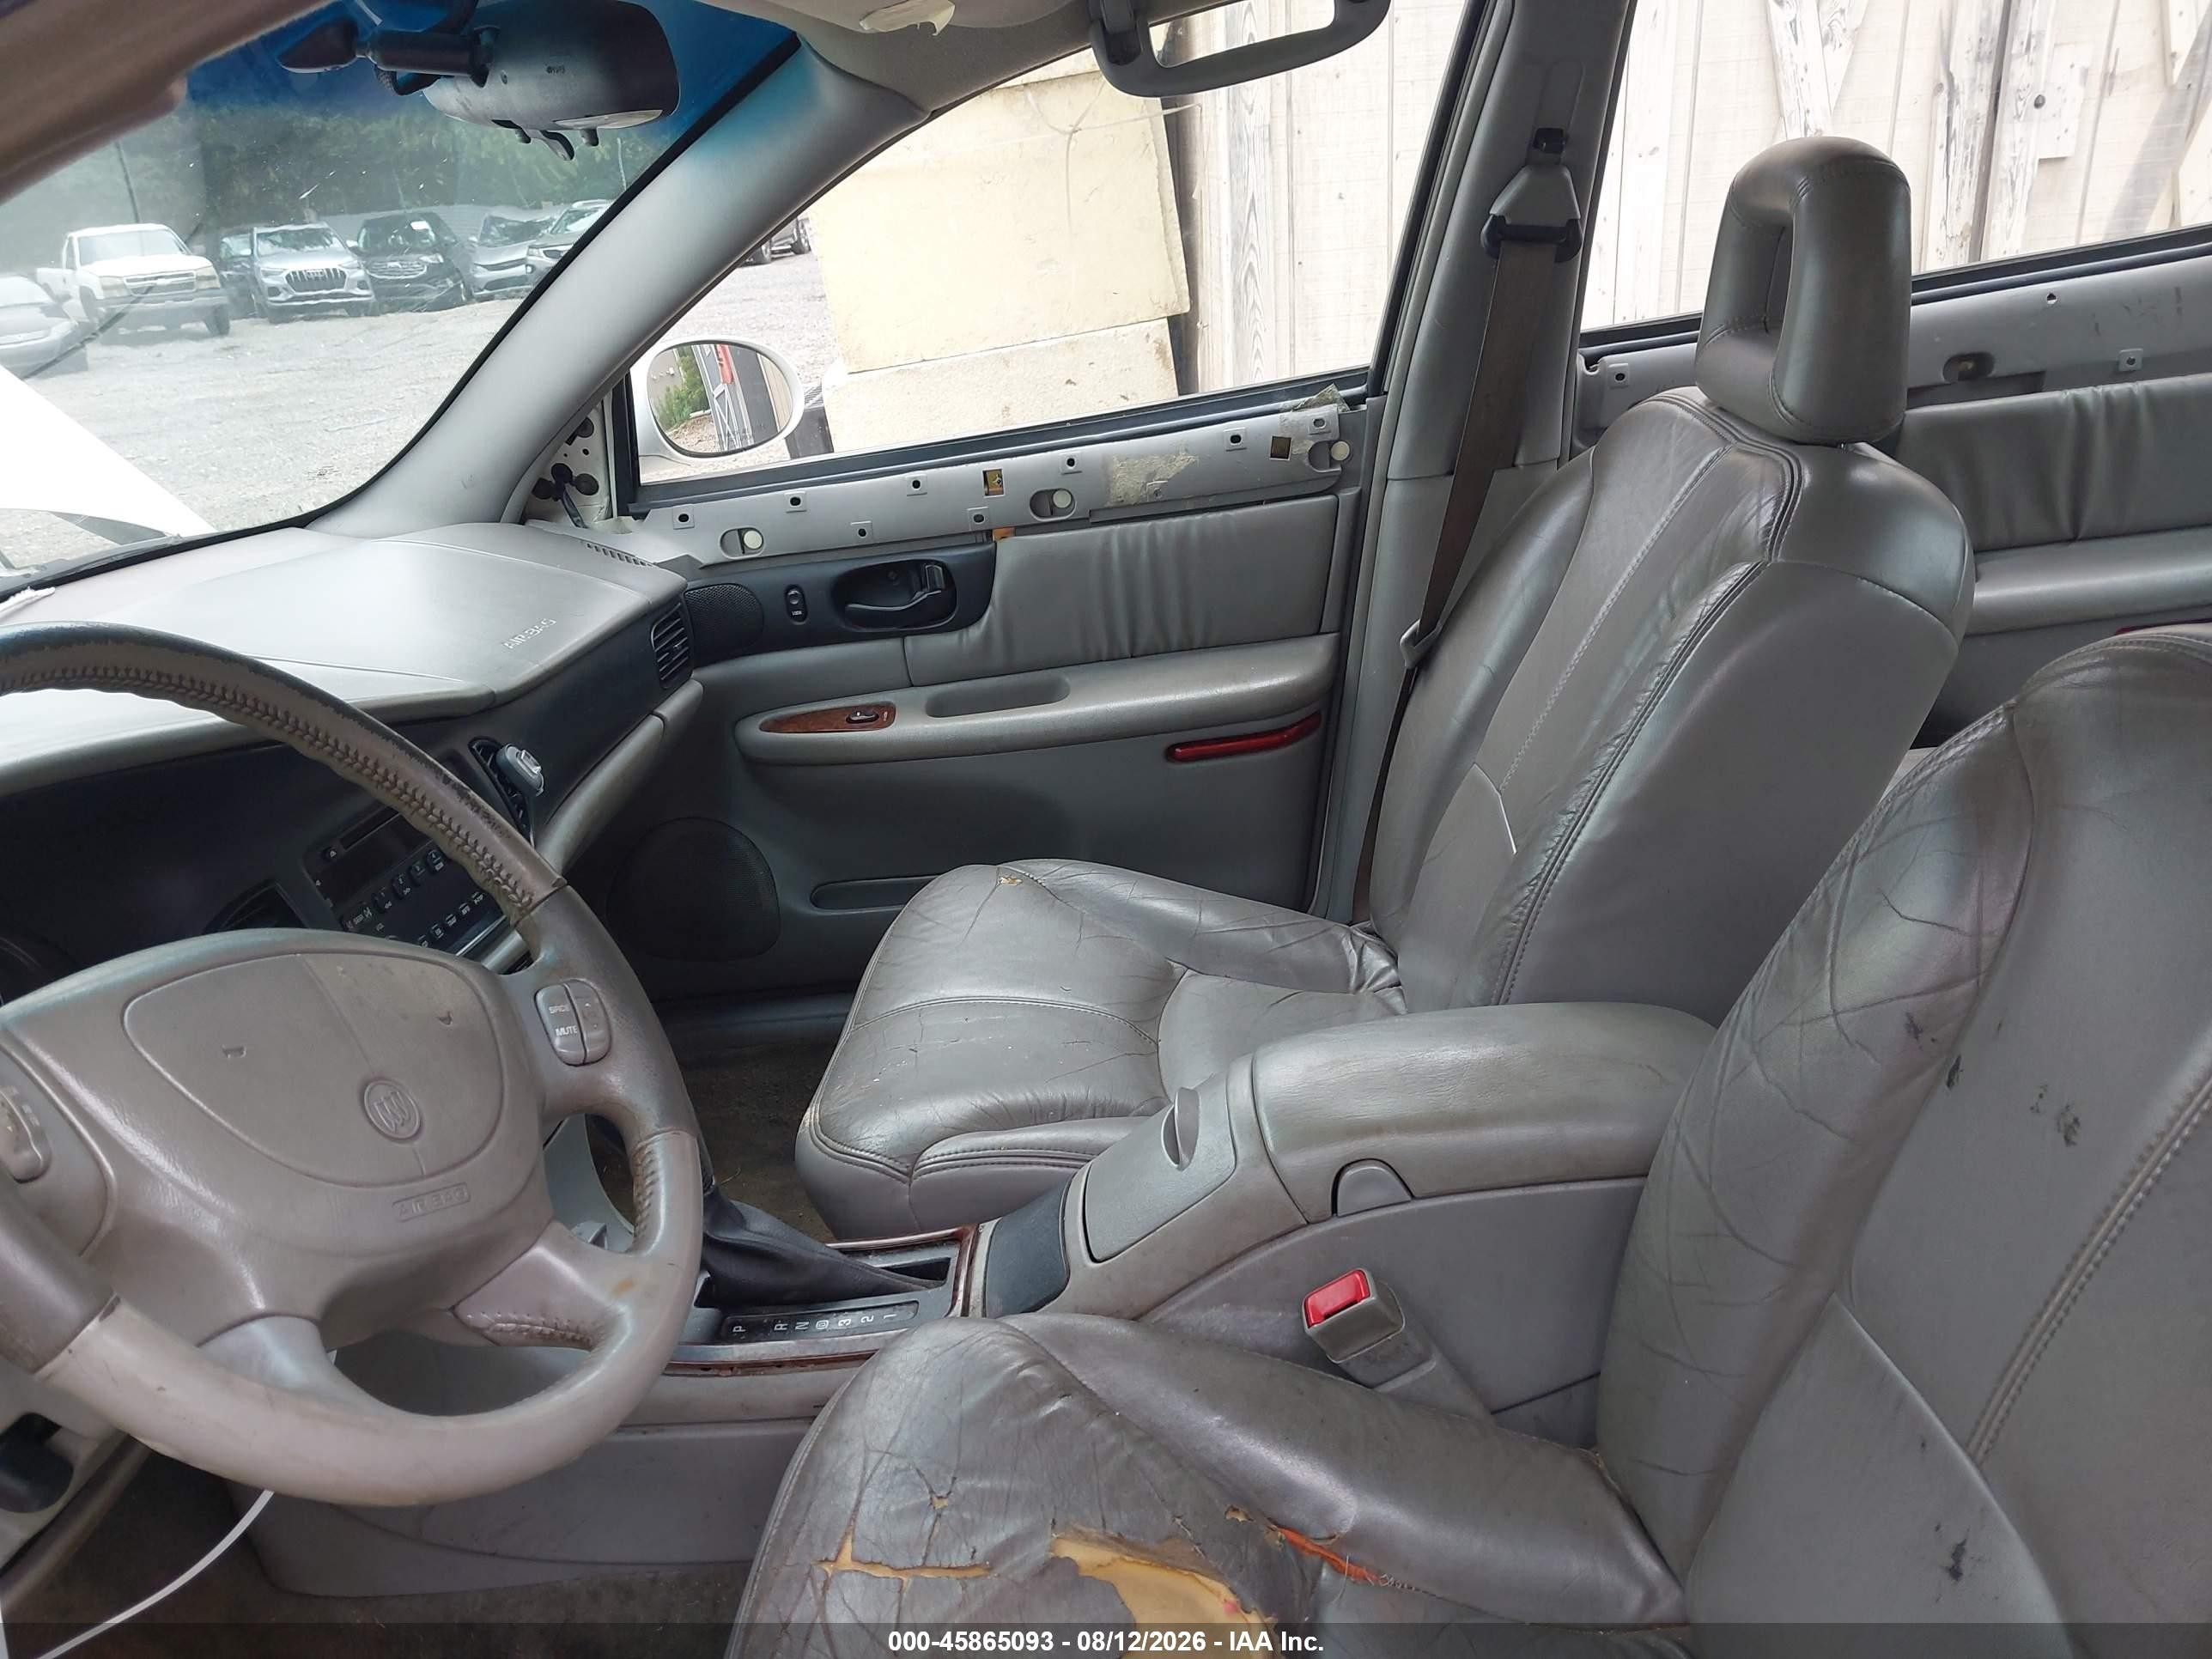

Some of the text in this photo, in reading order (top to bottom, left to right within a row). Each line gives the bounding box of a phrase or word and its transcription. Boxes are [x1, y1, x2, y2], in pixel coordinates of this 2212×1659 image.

[555, 1025, 578, 1036] MUTE
[795, 1322, 810, 1330] N
[837, 1318, 852, 1327] 3
[860, 1315, 874, 1323] 2
